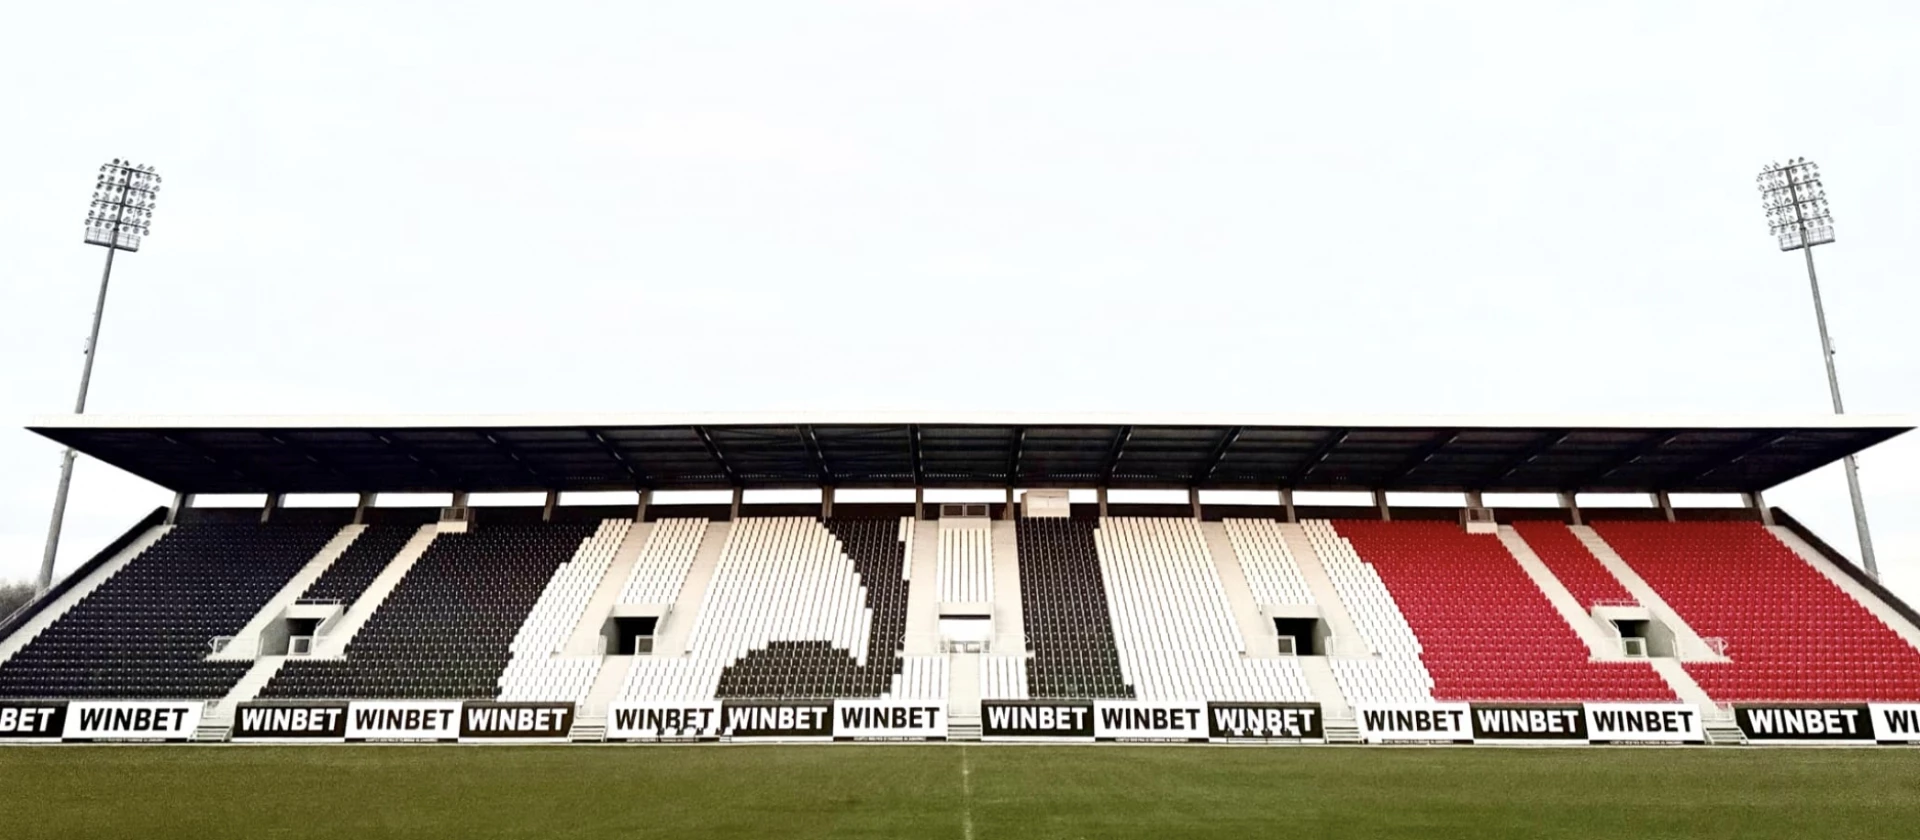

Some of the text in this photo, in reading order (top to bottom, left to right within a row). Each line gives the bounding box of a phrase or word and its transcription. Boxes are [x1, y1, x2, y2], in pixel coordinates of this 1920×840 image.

[80, 708, 189, 731] WINBET
[241, 708, 342, 731] WINBET
[355, 709, 454, 730] WINBET
[467, 708, 568, 731] WINBET
[615, 708, 714, 730] WINBET
[728, 707, 829, 730] WINBET
[841, 707, 940, 729] WINBET
[987, 706, 1088, 730] WINBET
[1101, 708, 1201, 730] WINBET
[1214, 708, 1315, 731] WINBET
[1363, 710, 1463, 731] WINBET
[1477, 710, 1579, 732] WINBET
[1593, 711, 1693, 732] WINBET
[1747, 709, 1858, 733] WINBET
